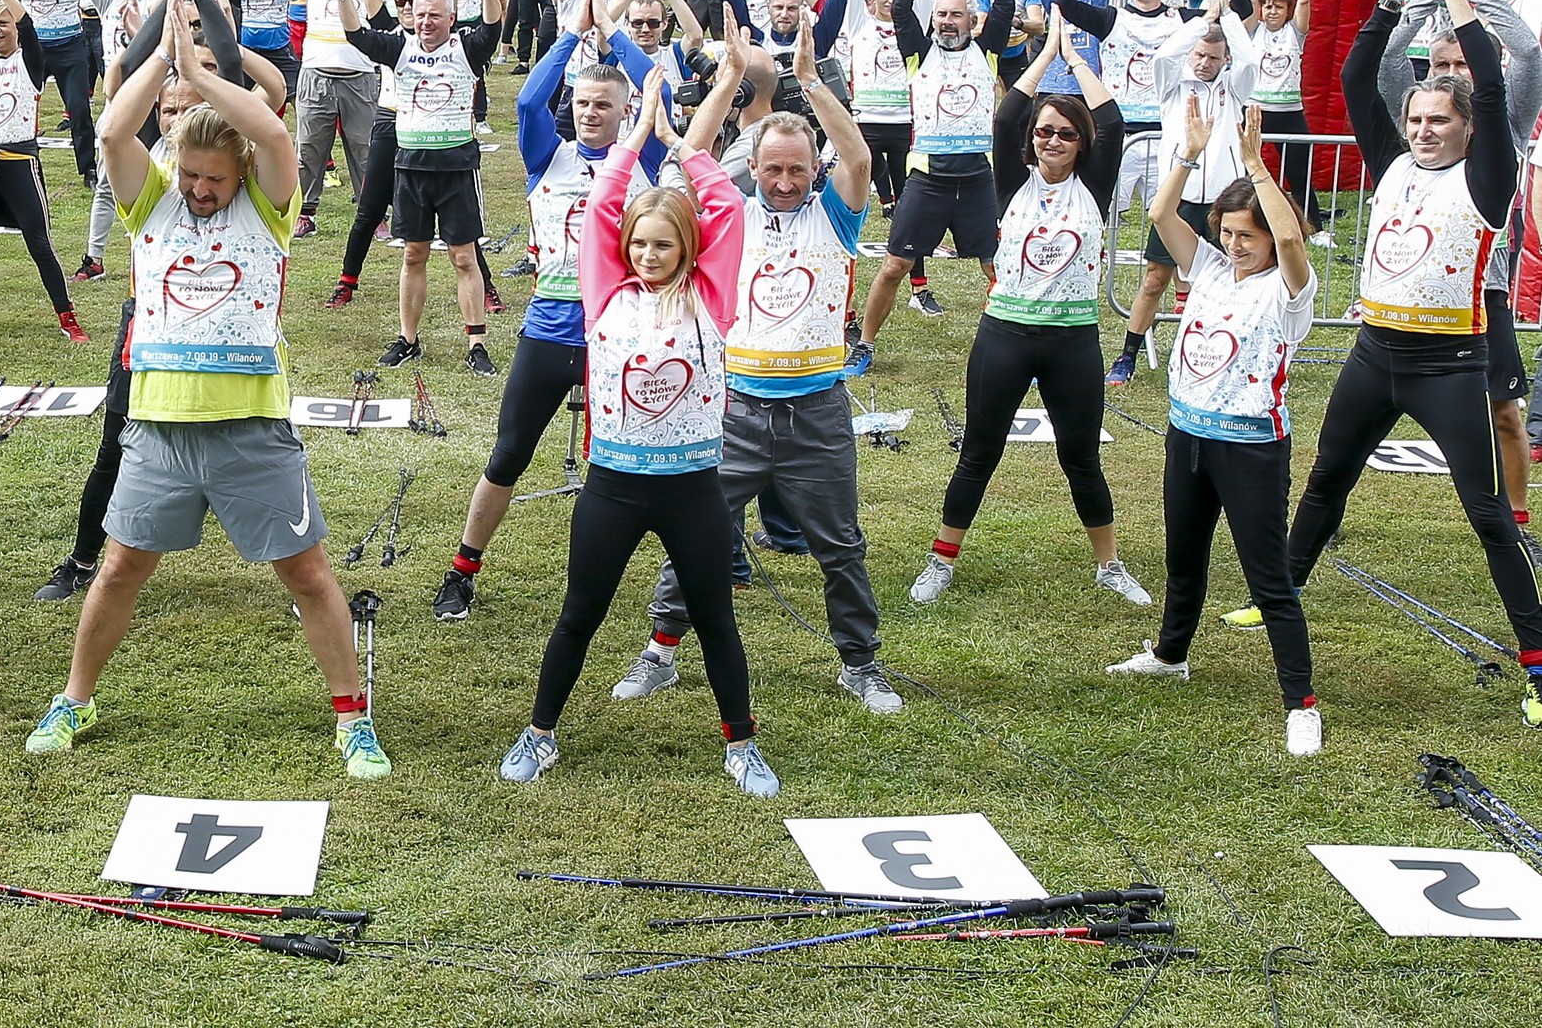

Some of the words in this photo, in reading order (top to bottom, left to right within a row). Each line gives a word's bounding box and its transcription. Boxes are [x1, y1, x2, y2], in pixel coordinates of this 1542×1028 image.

[543, 280, 577, 291] Warszawa
[994, 300, 1029, 313] Warszawa
[1035, 305, 1062, 315] 7.09.19
[1380, 311, 1410, 322] 7.09.19
[1418, 313, 1459, 324] Wilanów
[141, 351, 178, 361] Warszawa
[187, 351, 218, 362] 7.09.19
[226, 352, 264, 364] Wilanów
[768, 358, 801, 368] 7.09.19
[643, 378, 667, 387] BIEG
[635, 388, 647, 397] PO
[649, 385, 679, 395] NOWE
[308, 401, 392, 423] 16
[1186, 413, 1213, 427] 7.09.19
[1219, 420, 1258, 432] Wilanów
[596, 445, 637, 462] Warszawa
[645, 453, 677, 464] 7.09.19
[684, 446, 716, 461] Wilanów
[174, 813, 264, 874] 4
[862, 830, 962, 890] 3
[1390, 859, 1521, 921] 2
